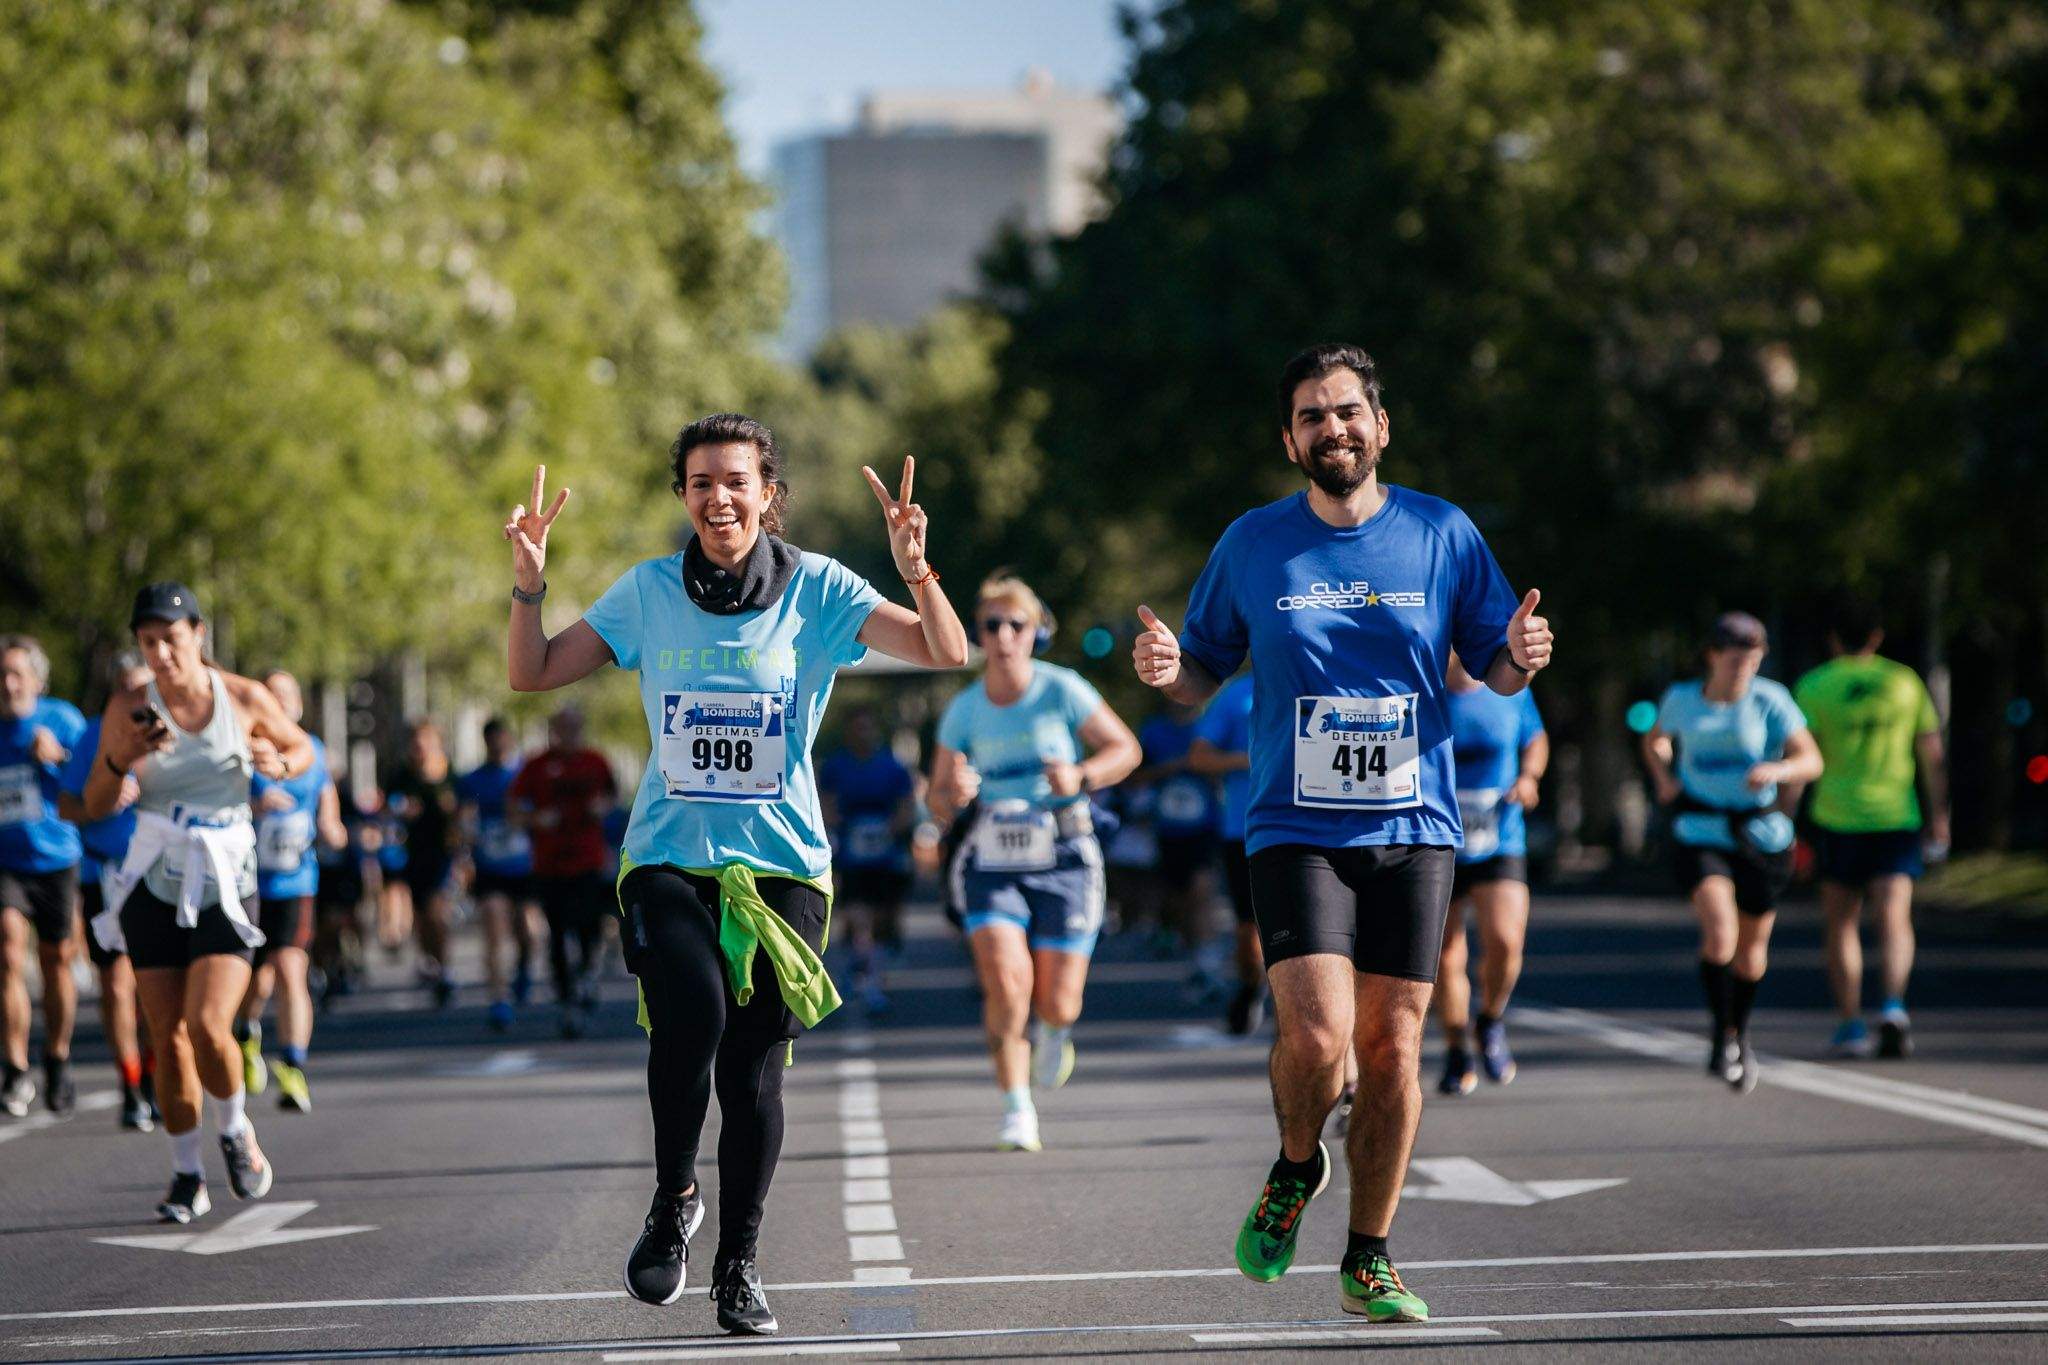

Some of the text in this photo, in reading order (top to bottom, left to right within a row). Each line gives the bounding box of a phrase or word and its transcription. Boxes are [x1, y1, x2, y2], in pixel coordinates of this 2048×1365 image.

[1310, 581, 1370, 595] CLUB
[702, 708, 761, 719] BOMBEROS
[1339, 713, 1398, 723] BOMBEROS
[695, 726, 759, 738] DECIMAS
[1332, 732, 1397, 742] DECIMAS
[692, 738, 753, 773] 998
[1332, 744, 1388, 777] 414
